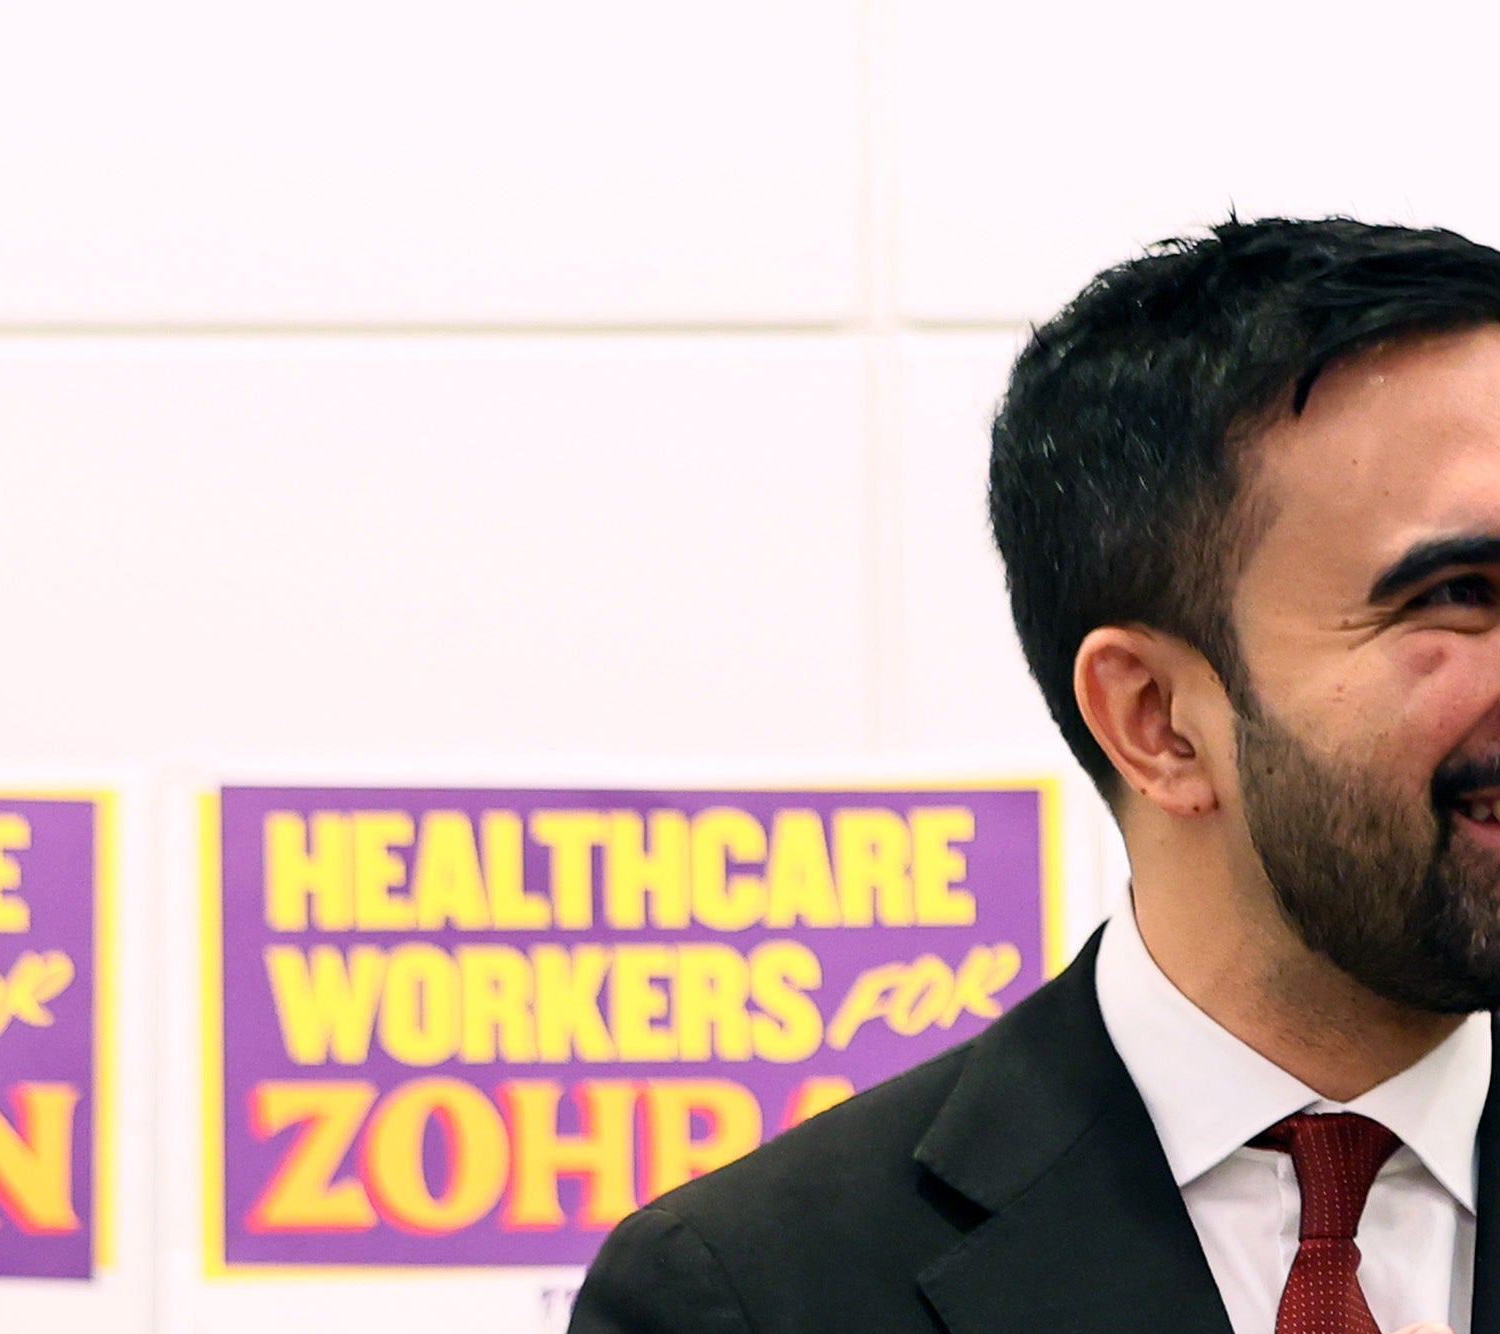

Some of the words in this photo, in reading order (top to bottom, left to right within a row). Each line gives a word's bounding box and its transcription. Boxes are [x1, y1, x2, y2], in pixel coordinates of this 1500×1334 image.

[265, 808, 976, 931] HEALTHCARE
[266, 940, 824, 1065] WORKERS
[828, 944, 1022, 1052] FOR
[243, 1075, 856, 1237] ZOHR
